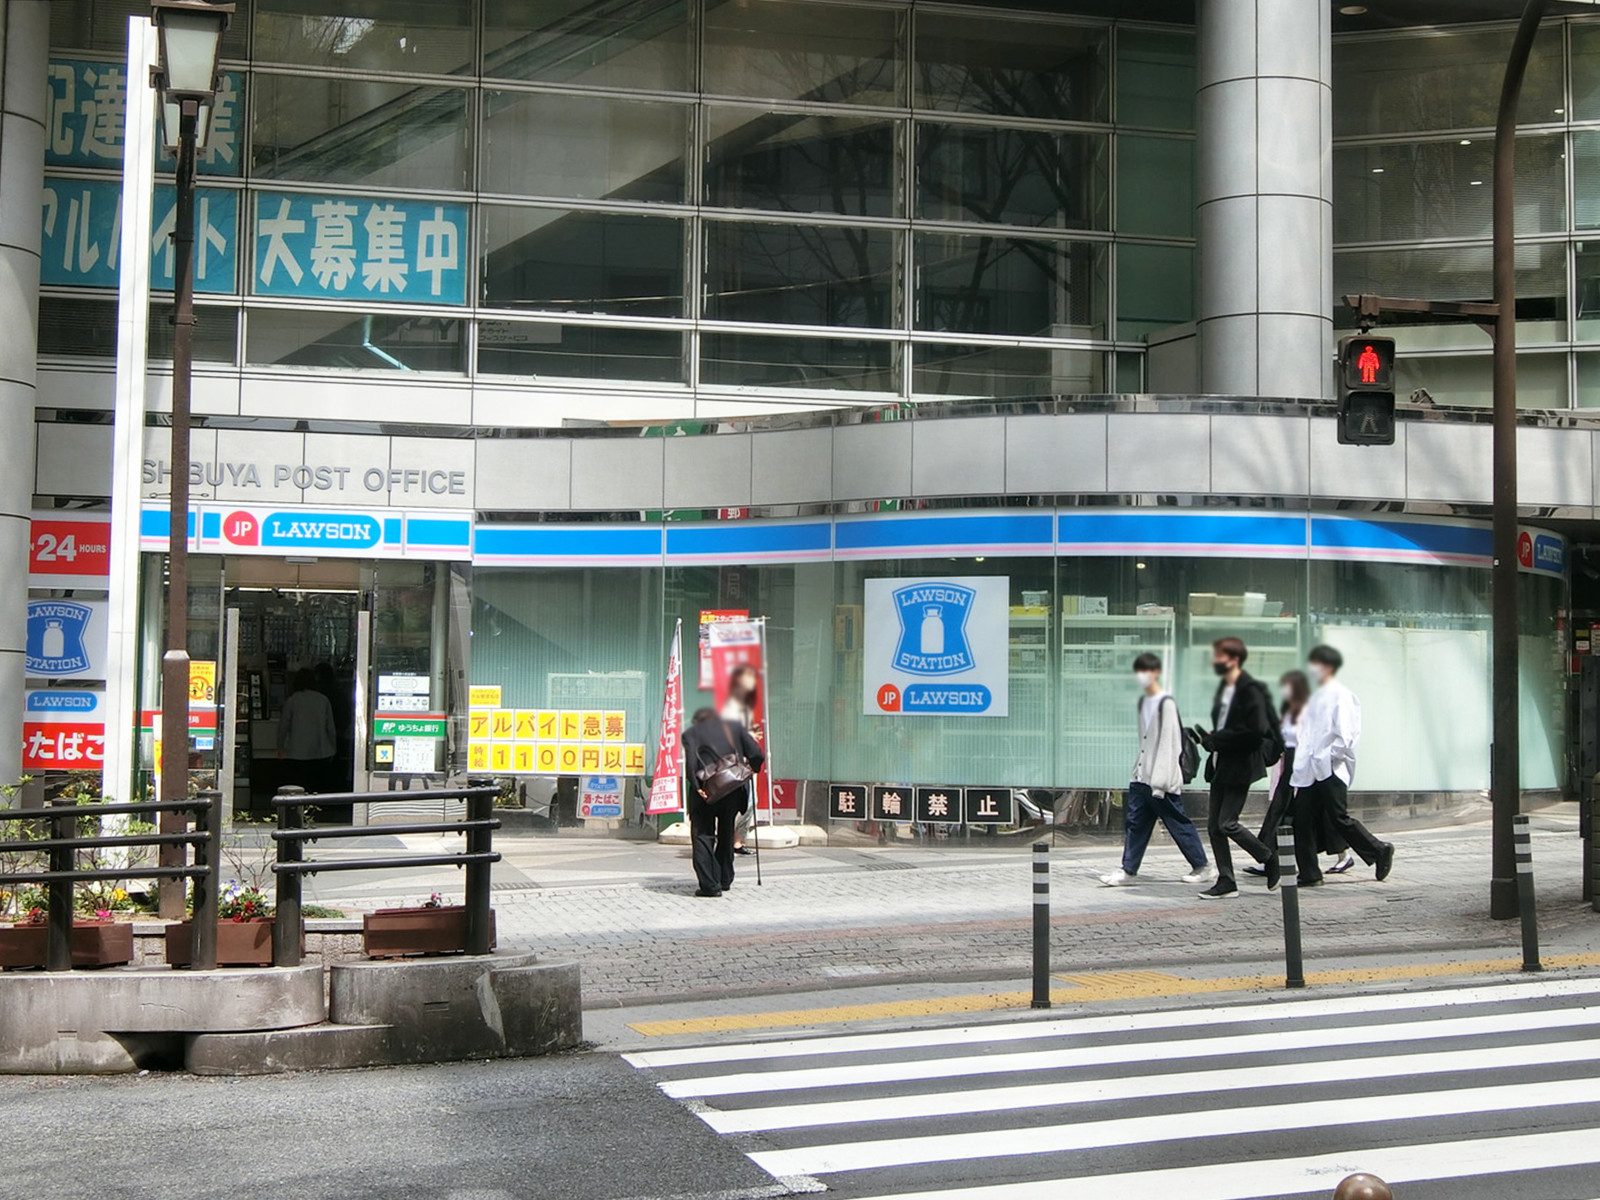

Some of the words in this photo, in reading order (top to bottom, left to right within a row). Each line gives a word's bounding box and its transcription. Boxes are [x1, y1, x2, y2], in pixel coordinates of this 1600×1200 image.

[259, 198, 459, 296] 大募集中
[143, 459, 261, 488] SHBUYA
[274, 464, 350, 490] POST
[364, 468, 466, 494] OFFICE
[231, 521, 253, 537] JP
[273, 521, 371, 540] LAWSON
[36, 534, 77, 562] 24
[79, 544, 107, 554] HOURS
[900, 589, 968, 607] LAWSON
[900, 652, 967, 670] STATION
[33, 696, 92, 707] LAWSON
[882, 691, 897, 705] JP
[910, 691, 984, 706] LAWSON
[471, 715, 624, 737] アルバイト急募
[838, 791, 999, 817] 駐輪禁止
